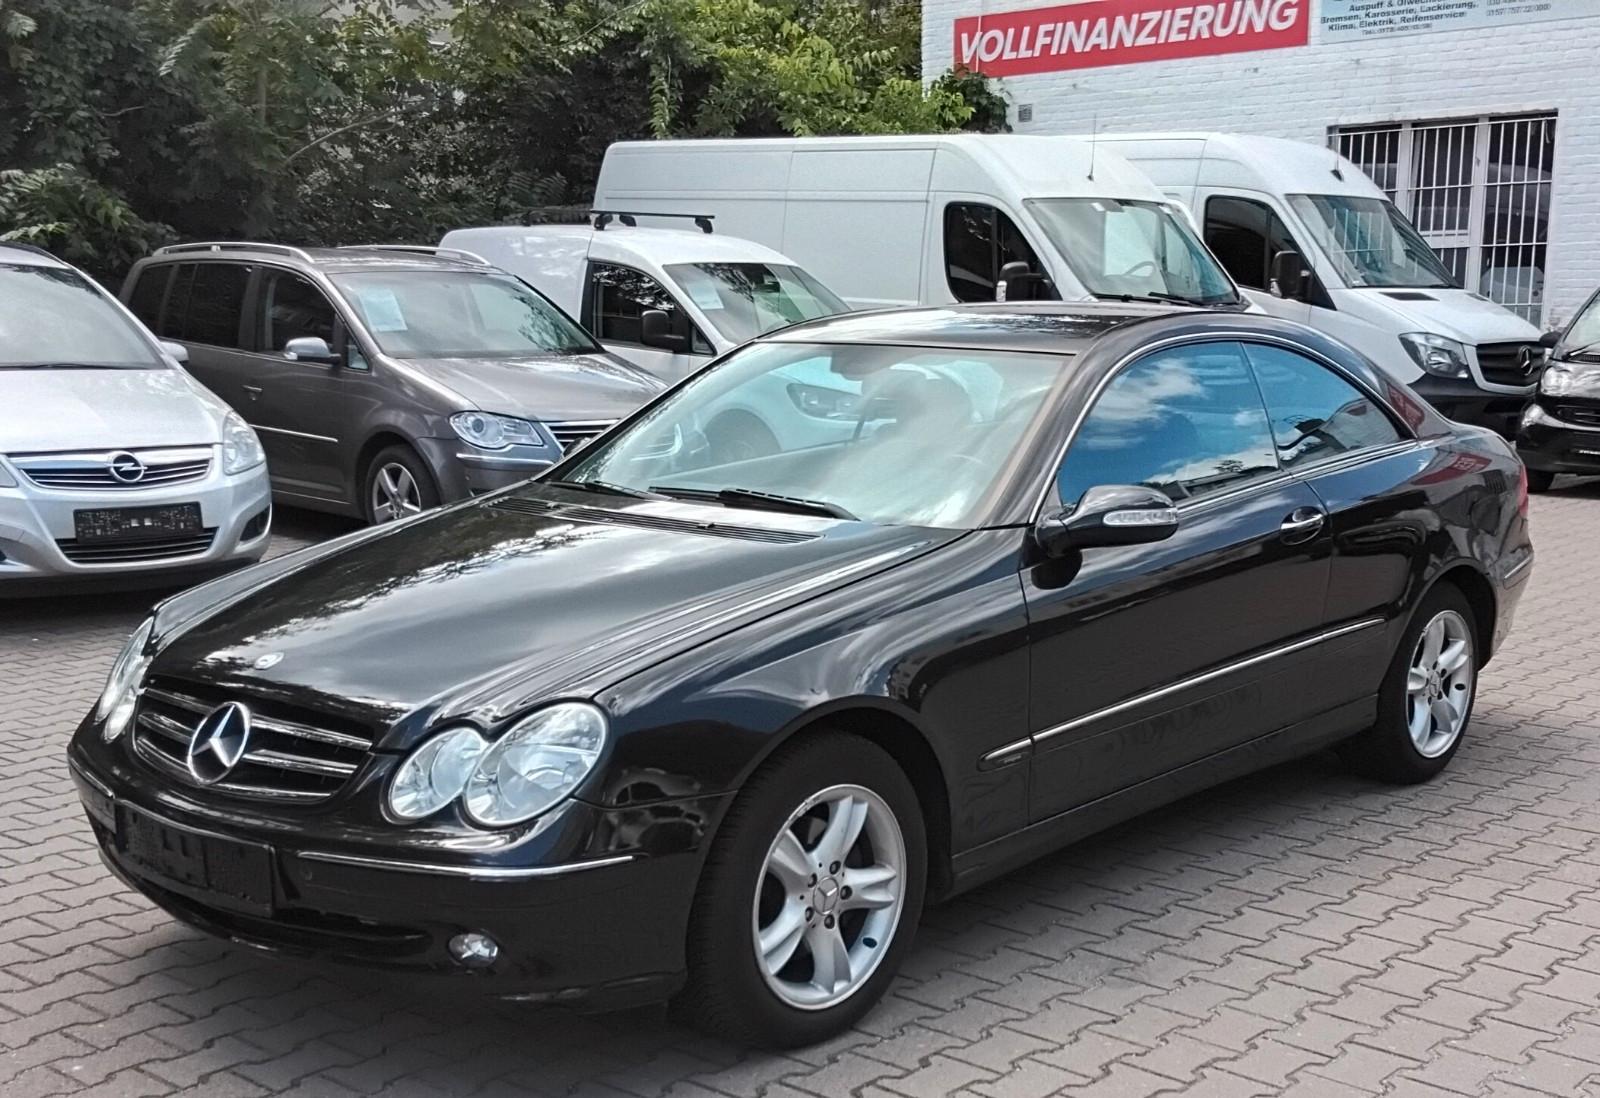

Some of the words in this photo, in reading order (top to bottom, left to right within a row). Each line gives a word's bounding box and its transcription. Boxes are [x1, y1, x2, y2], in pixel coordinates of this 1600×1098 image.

[1349, 2, 1383, 13] Auspuff
[1364, 7, 1416, 19] Karosserie,
[1400, 11, 1465, 24] Reifenservice
[960, 0, 1299, 65] VOLLFINANZIERUNG
